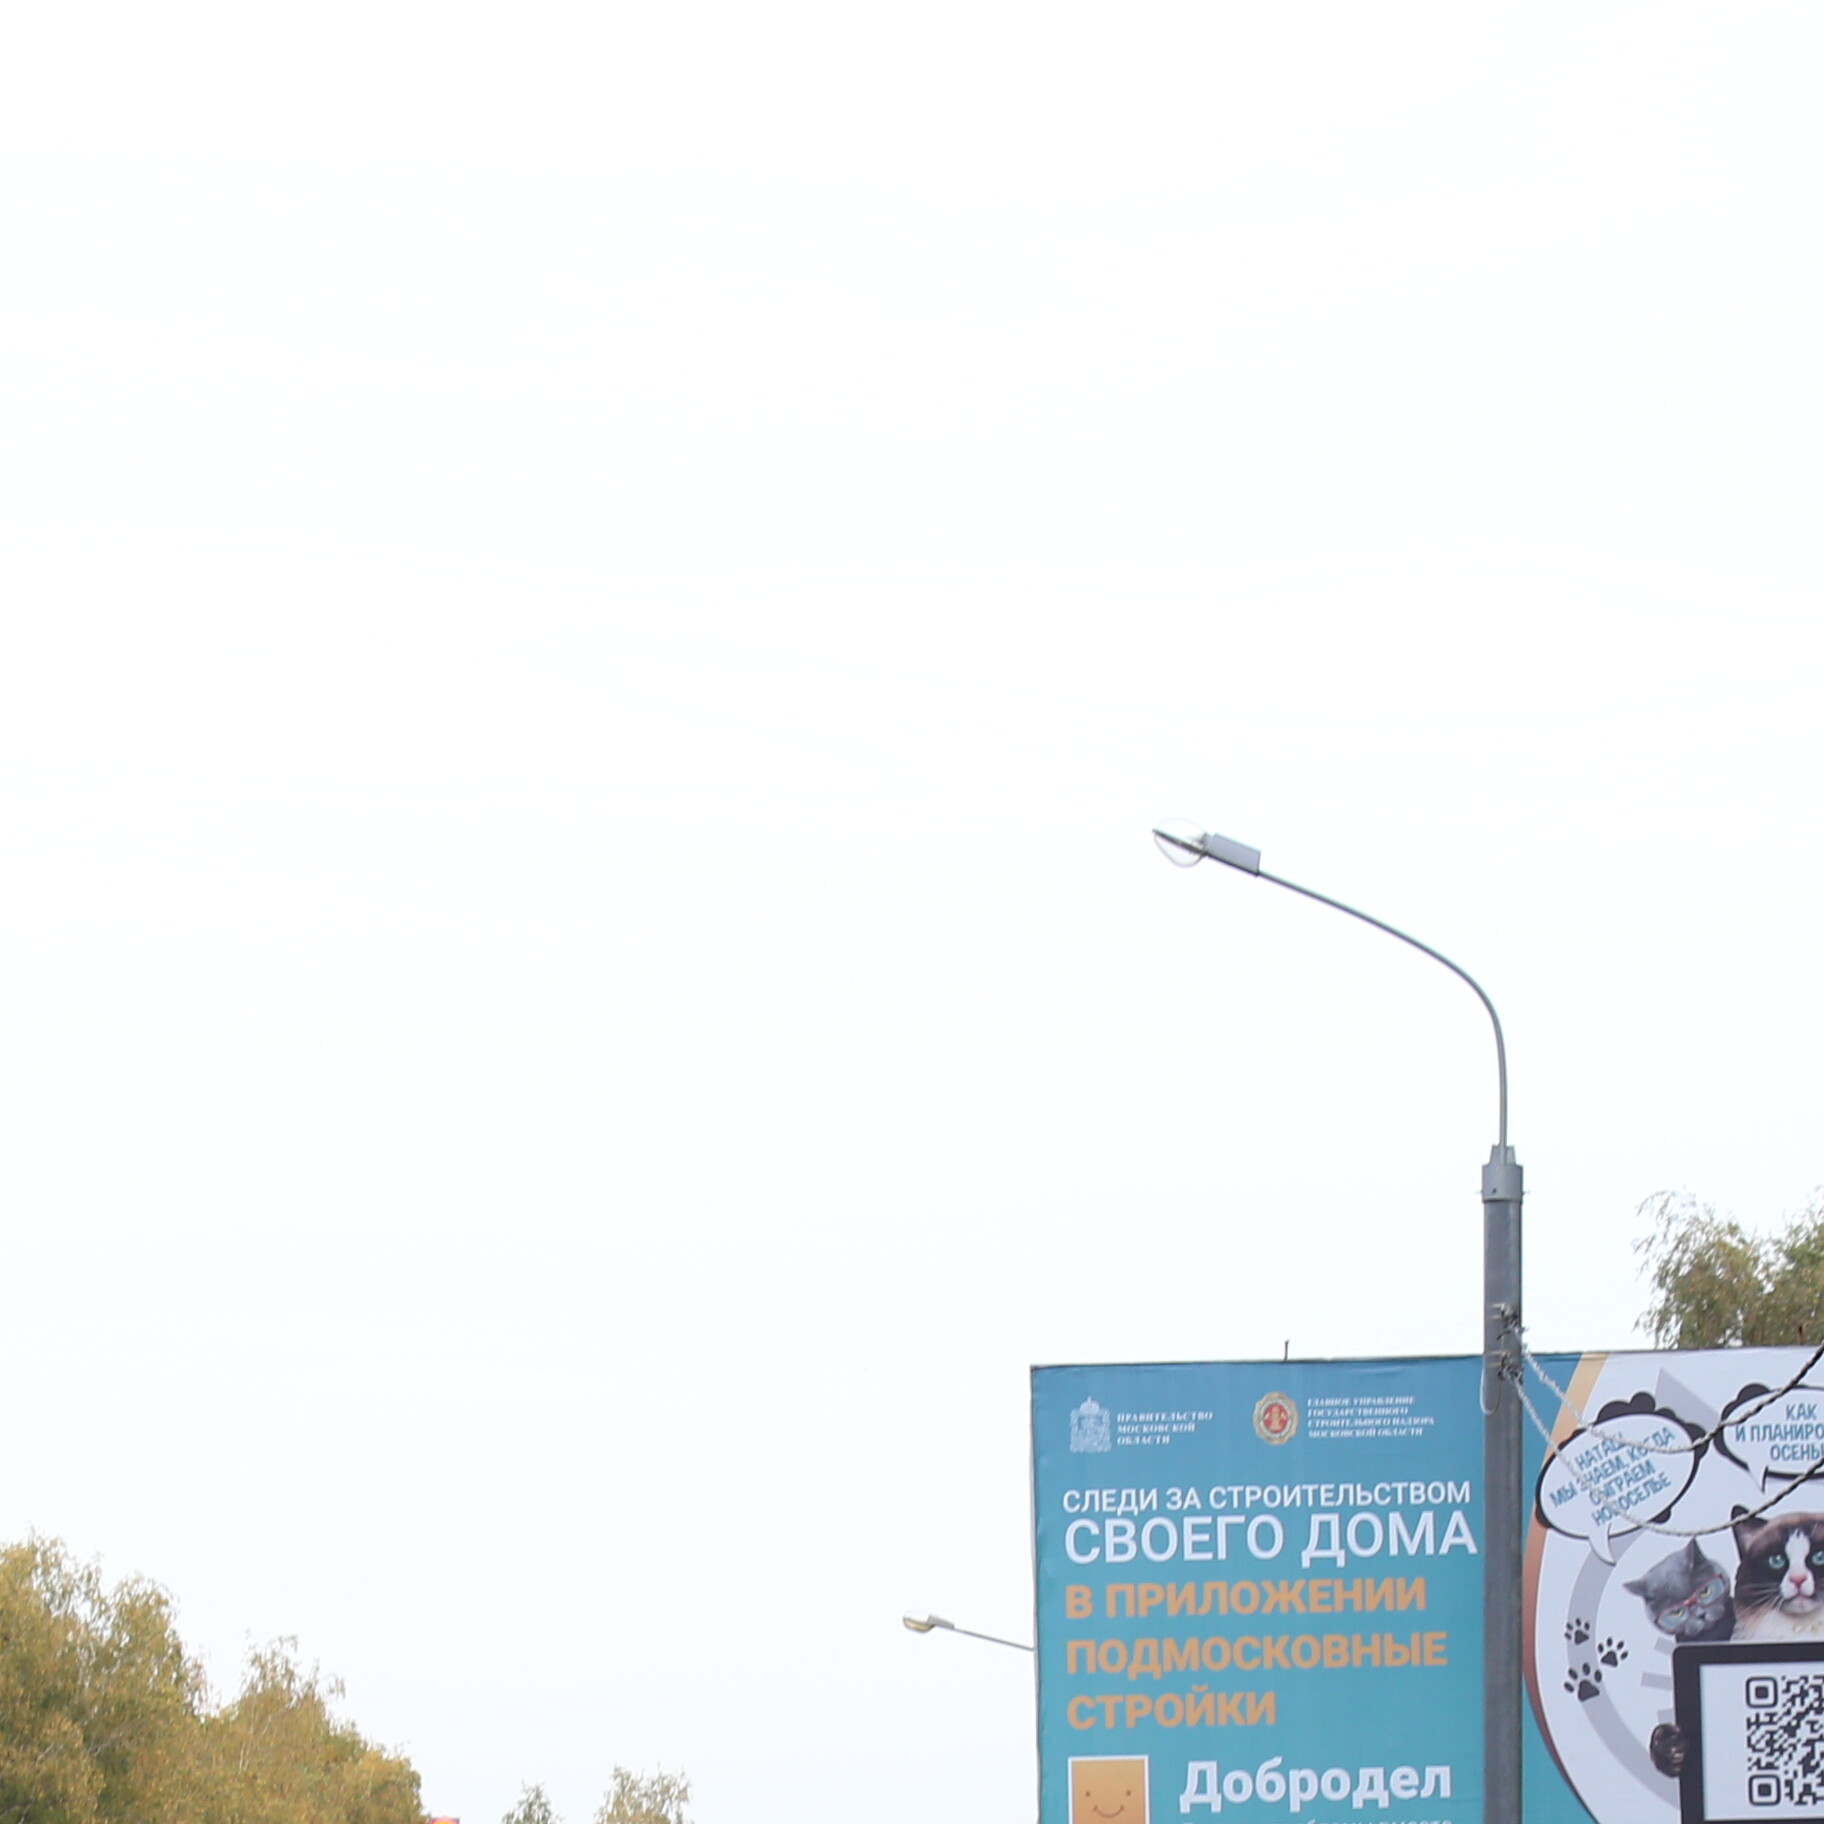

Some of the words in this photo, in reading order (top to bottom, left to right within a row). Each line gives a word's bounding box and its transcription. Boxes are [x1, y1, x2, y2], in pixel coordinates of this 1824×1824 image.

[1117, 1411, 1213, 1423] ПРАВИТЕЛЬСТВО
[1117, 1422, 1196, 1434] МОСКОВСКОЙ
[1786, 1403, 1817, 1422] КАК
[1117, 1434, 1170, 1445] ОБЛАСТИ
[1735, 1424, 1746, 1442] И
[1062, 1488, 1158, 1516] СЛЕДИ
[1166, 1487, 1201, 1511] ЗА
[1209, 1480, 1471, 1510] СТРОИТЕЛЬСТВОМ
[1549, 1481, 1577, 1508] МЫ
[1064, 1513, 1285, 1565] СВОЕГО
[1301, 1510, 1478, 1569] ДОМА
[1065, 1585, 1093, 1619] В
[1106, 1577, 1426, 1617] ПРИЛОЖЕНИИ
[1066, 1631, 1448, 1679] ПОДМОСКОВНЫЕ
[1066, 1684, 1276, 1730] СТРОЙКИ
[1179, 1756, 1452, 1814] Добродел
